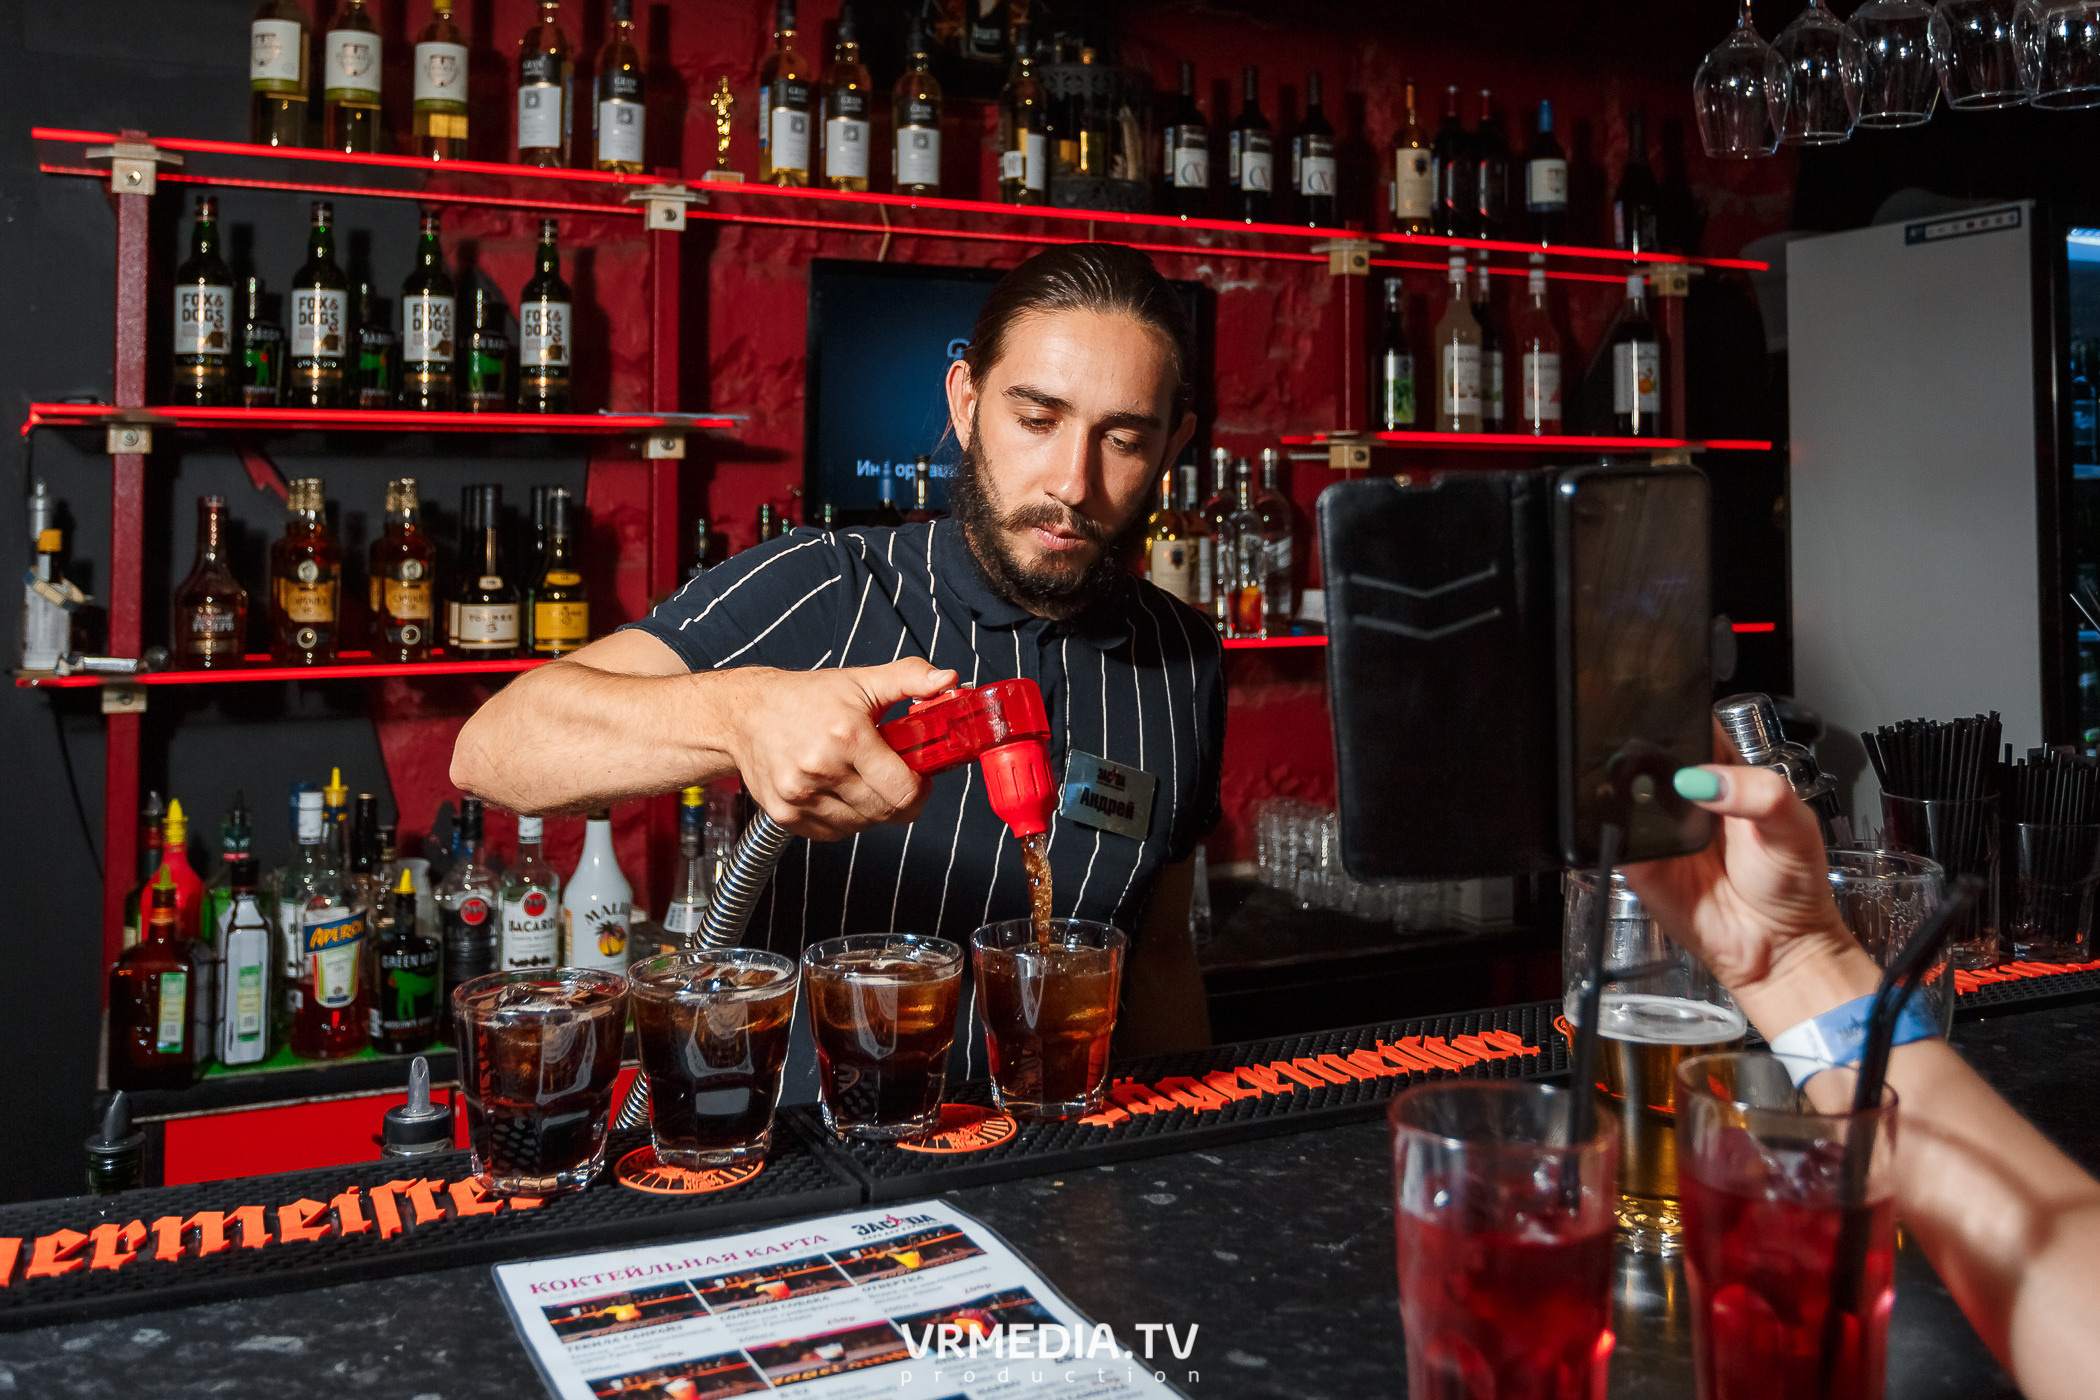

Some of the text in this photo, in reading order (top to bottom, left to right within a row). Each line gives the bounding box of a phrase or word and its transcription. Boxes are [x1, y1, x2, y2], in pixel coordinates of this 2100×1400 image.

[1080, 786, 1135, 820] Андрей
[585, 902, 629, 926] MALI
[309, 920, 364, 949] APERO
[0, 1176, 544, 1287] ermeiste
[528, 1234, 829, 1294] КОКТЕЙЛЬНАЯ КАРТА
